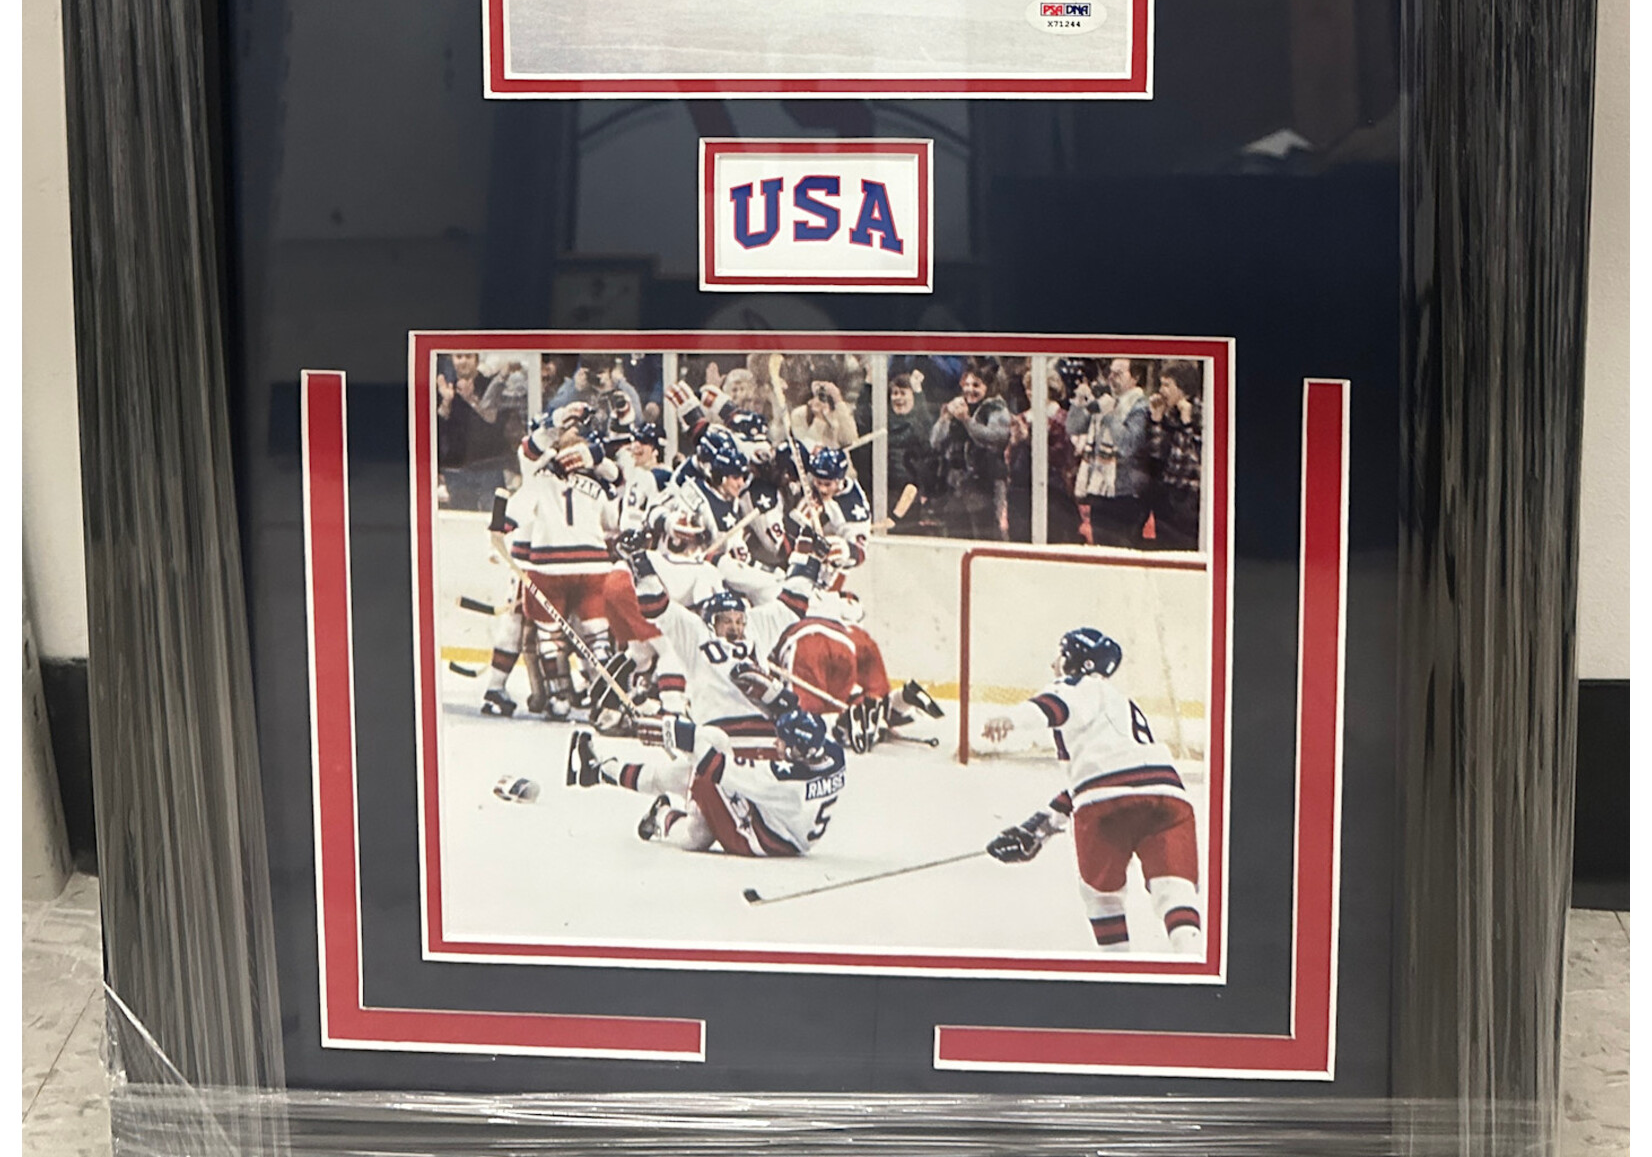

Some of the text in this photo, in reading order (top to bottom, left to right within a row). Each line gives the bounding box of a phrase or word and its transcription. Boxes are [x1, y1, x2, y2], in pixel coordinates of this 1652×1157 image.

[1042, 4, 1089, 16] PSA DNA
[1046, 19, 1082, 28] X71244
[729, 174, 904, 255] USA
[562, 487, 574, 527] 1
[807, 795, 838, 842] 5
